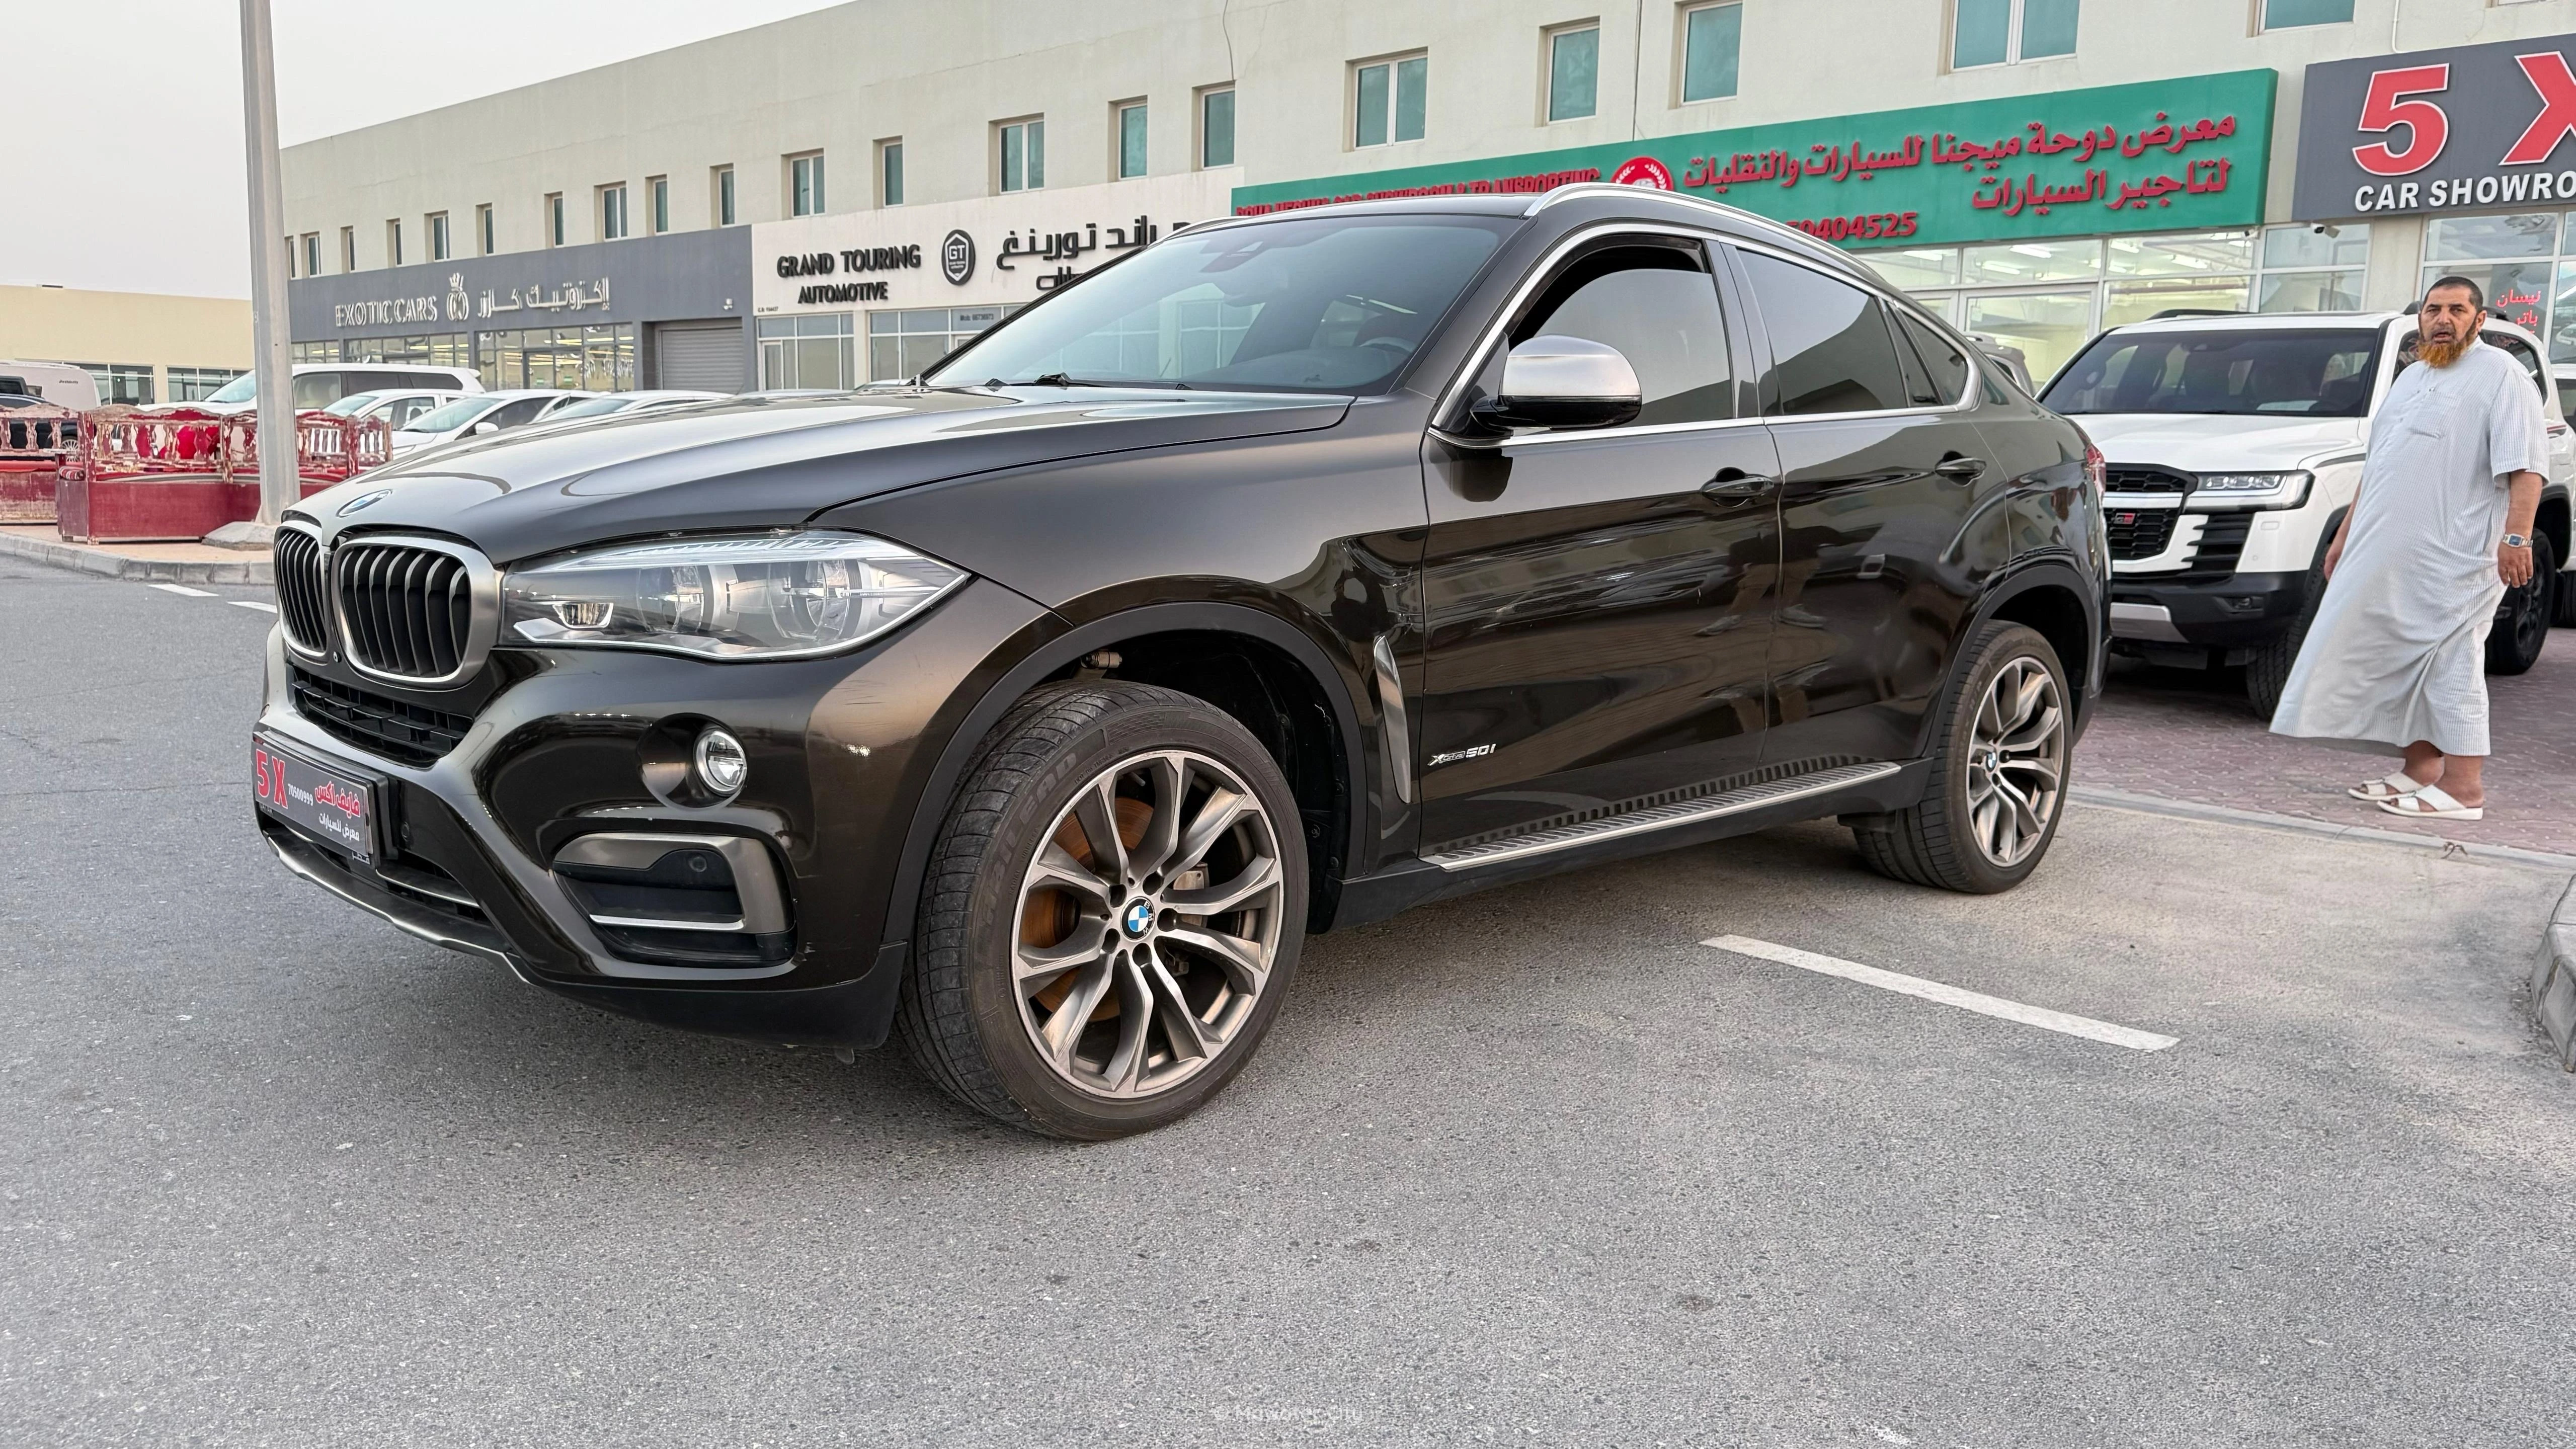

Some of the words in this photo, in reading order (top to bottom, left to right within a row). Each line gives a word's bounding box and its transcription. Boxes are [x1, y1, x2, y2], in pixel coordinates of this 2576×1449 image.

[2352, 63, 2449, 176] 5
[2499, 51, 2576, 166] X
[2027, 122, 2116, 162] دوحة
[2121, 112, 2235, 157] معرض
[1804, 135, 1924, 181] للسيارات
[1931, 134, 2021, 171] ميجنا
[1683, 150, 1800, 193] والنقليات
[1972, 169, 2106, 215] السيارات
[2355, 182, 2419, 212] CAR
[2429, 171, 2576, 208] SHOWRO
[1105, 215, 1192, 250] راند
[1786, 211, 1917, 241] 0404525
[777, 253, 835, 278] GRAND
[840, 244, 922, 272] TOURING
[949, 245, 965, 260] GT
[996, 222, 1097, 270] تورينغ
[477, 287, 522, 318] كارز
[797, 281, 888, 304] AUTOMOTIVE
[2496, 289, 2541, 308] نيسان
[335, 301, 393, 327] EXOTIC
[393, 296, 437, 323] CARS
[256, 748, 270, 798] 5
[272, 756, 288, 809] X
[336, 787, 361, 819] فايف
[318, 813, 342, 833] للسيارات
[342, 823, 360, 842] معرض
